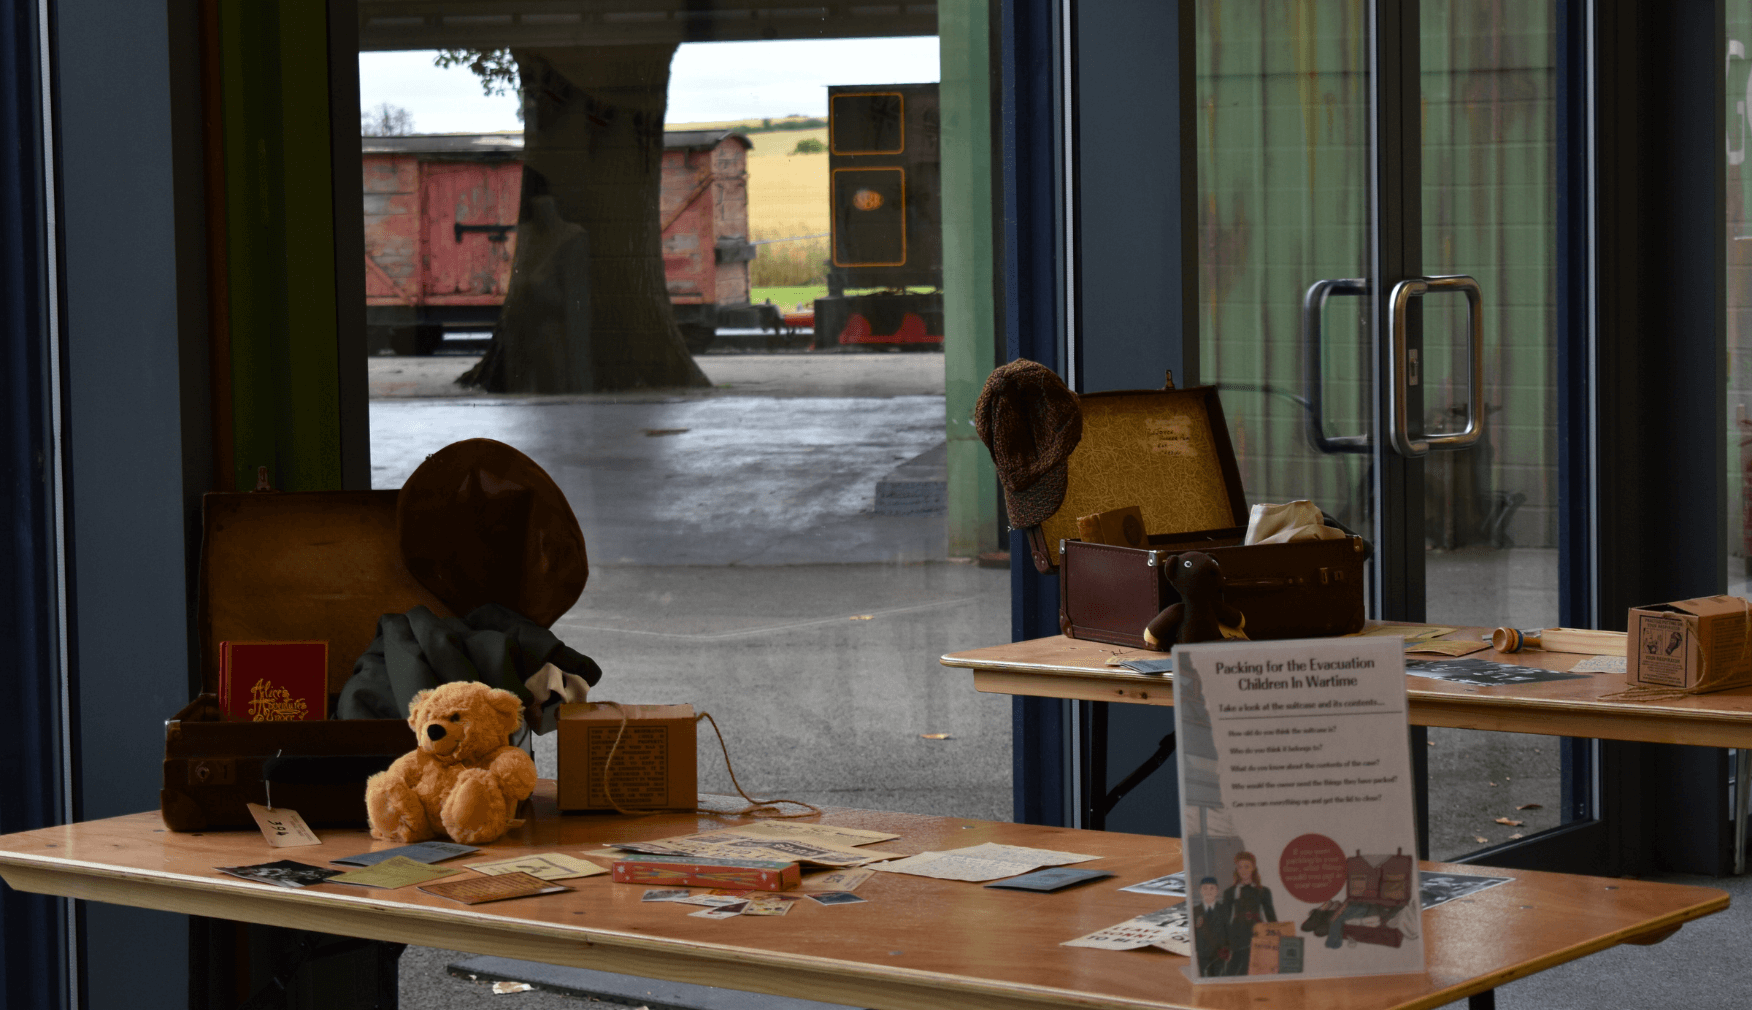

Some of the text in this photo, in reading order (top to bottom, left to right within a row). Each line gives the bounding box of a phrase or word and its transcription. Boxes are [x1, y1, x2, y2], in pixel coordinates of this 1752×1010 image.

[1216, 657, 1375, 675] Packing for the Evacuation
[1238, 675, 1358, 691] Children In Wartime
[1218, 704, 1237, 712] Take
[1244, 702, 1260, 711] look
[1262, 703, 1270, 711] at
[1272, 702, 1284, 710] the
[1286, 702, 1316, 710] suitcase
[1318, 700, 1332, 709] and
[1333, 700, 1343, 708] its
[1276, 728, 1290, 736] think
[1292, 727, 1302, 735] the
